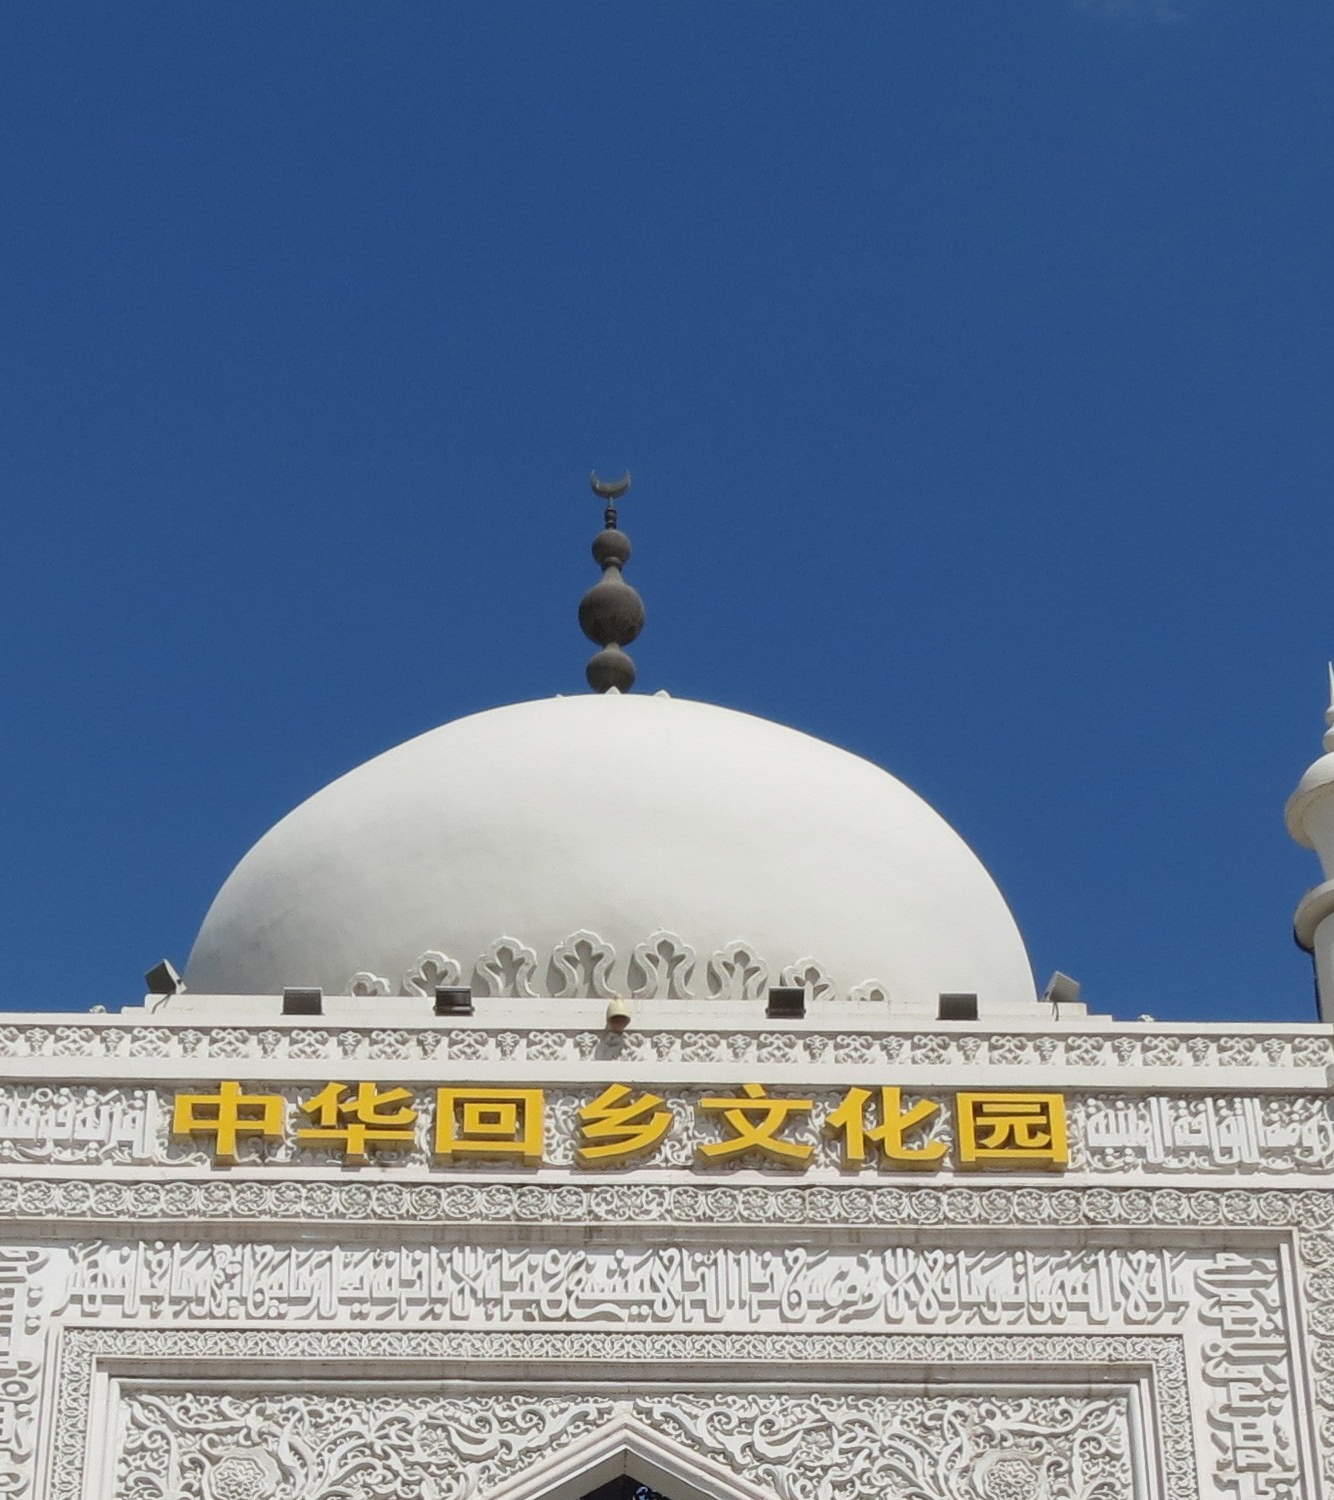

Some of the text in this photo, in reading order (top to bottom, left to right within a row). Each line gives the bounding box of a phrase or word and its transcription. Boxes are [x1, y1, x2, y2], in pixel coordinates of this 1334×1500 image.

[171, 1080, 1067, 1170] 中华回乡文化园
